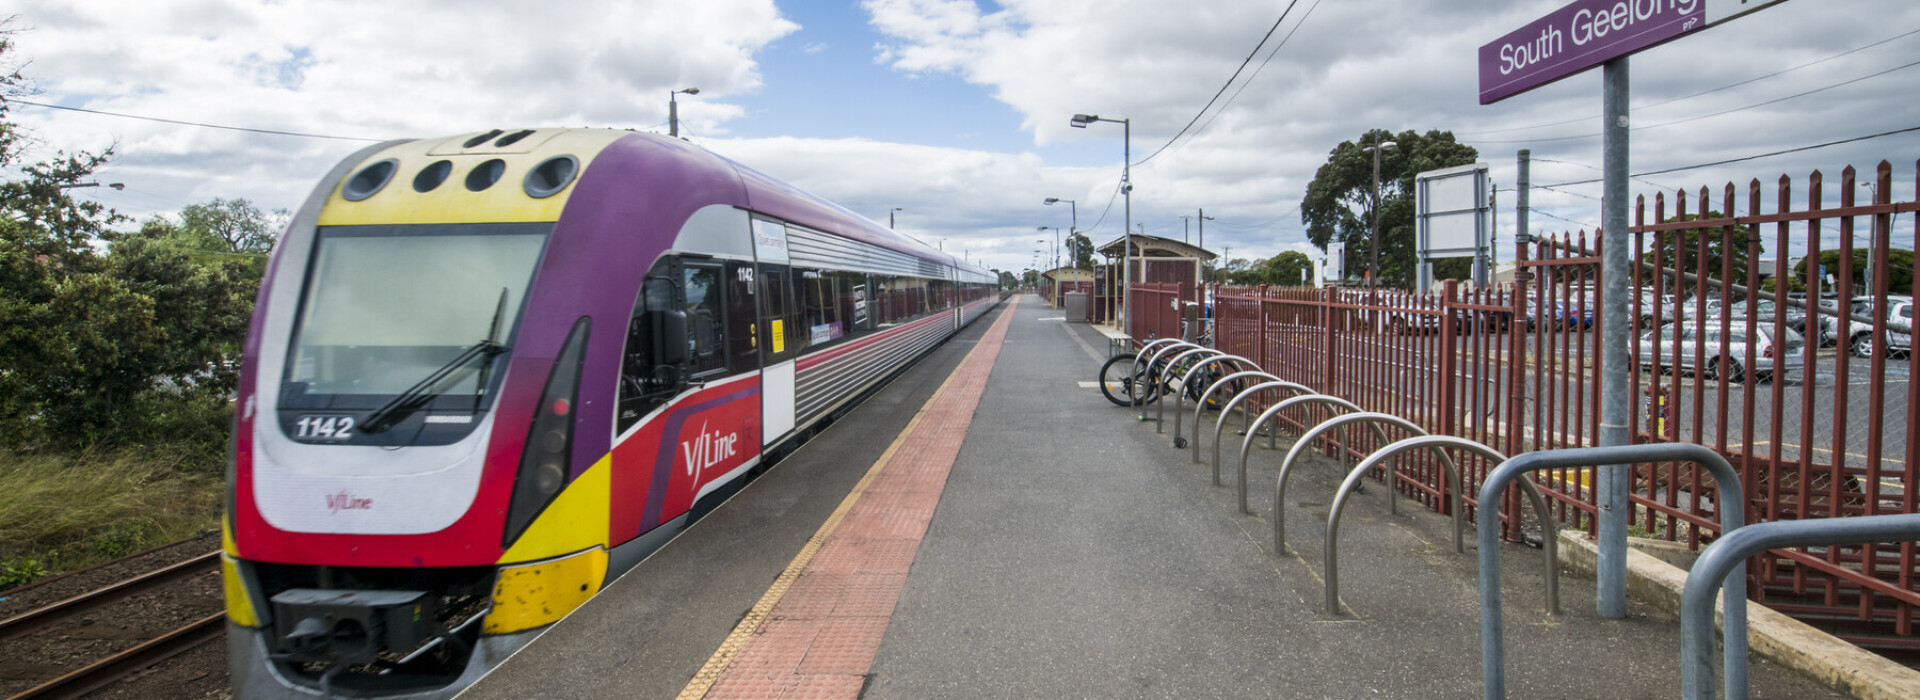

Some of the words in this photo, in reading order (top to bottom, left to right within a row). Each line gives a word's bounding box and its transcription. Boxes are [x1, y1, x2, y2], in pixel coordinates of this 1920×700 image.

[1500, 24, 1562, 75] South
[737, 267, 753, 281] 1142
[297, 415, 355, 438] 1142
[682, 419, 737, 491] V/Line
